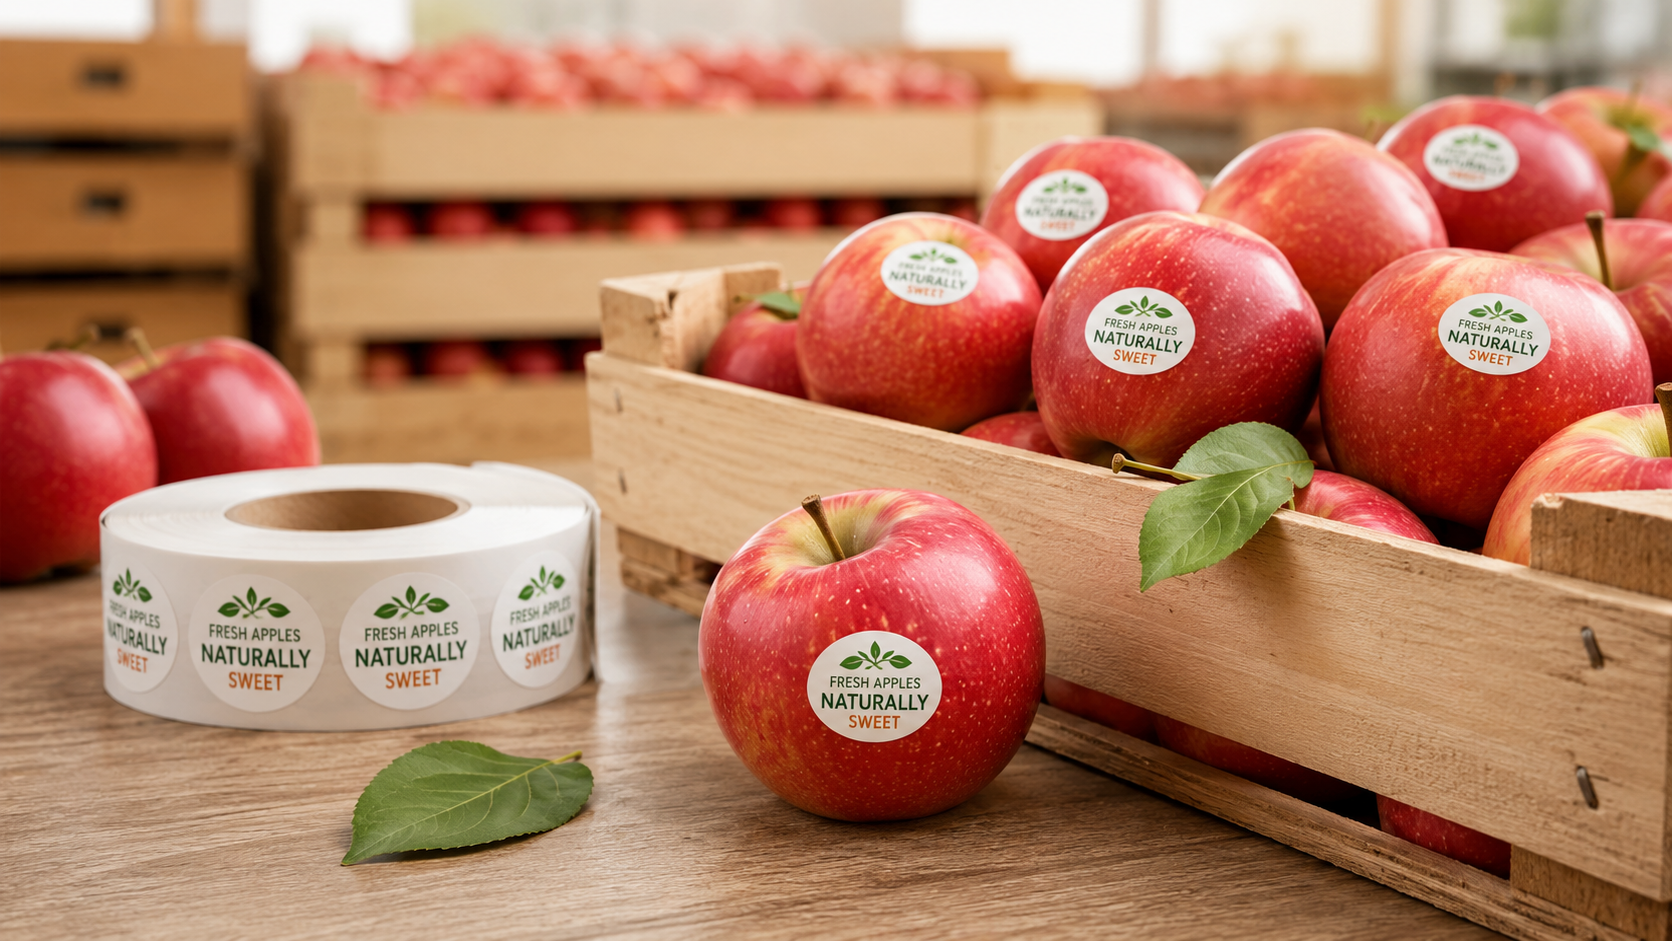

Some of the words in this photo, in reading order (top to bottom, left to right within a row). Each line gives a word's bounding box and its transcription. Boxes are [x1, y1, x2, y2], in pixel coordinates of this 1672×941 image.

[889, 271, 967, 290] NATURALLY
[907, 285, 945, 299] SWEET
[1104, 317, 1136, 330] FRESH
[1138, 322, 1178, 336] APPLES
[1458, 319, 1491, 332] FRESH
[1494, 325, 1533, 340] APPLES
[1093, 329, 1183, 354] NATURALLY
[1447, 329, 1539, 357] NATURALLY
[1113, 349, 1157, 365] SWEET
[1468, 349, 1513, 366] SWEET
[129, 609, 160, 629] APPLES
[510, 606, 540, 625] FRESH
[542, 595, 571, 618] APPLES
[107, 617, 168, 656] NATURALLY
[209, 623, 247, 640] FRESH
[251, 627, 301, 642] APPLES
[364, 626, 407, 641] FRESH
[411, 621, 459, 639] APPLES
[503, 613, 575, 652] NATURALLY
[117, 648, 148, 673] SWEET
[201, 643, 311, 669] NATURALLY
[355, 640, 467, 668] NATURALLY
[525, 643, 561, 670] SWEET
[228, 671, 284, 691] SWEET
[385, 668, 442, 690] SWEET
[830, 676, 869, 689] FRESH
[873, 677, 921, 689] APPLES
[821, 692, 929, 711] NATURALLY
[848, 714, 901, 729] SWEET
